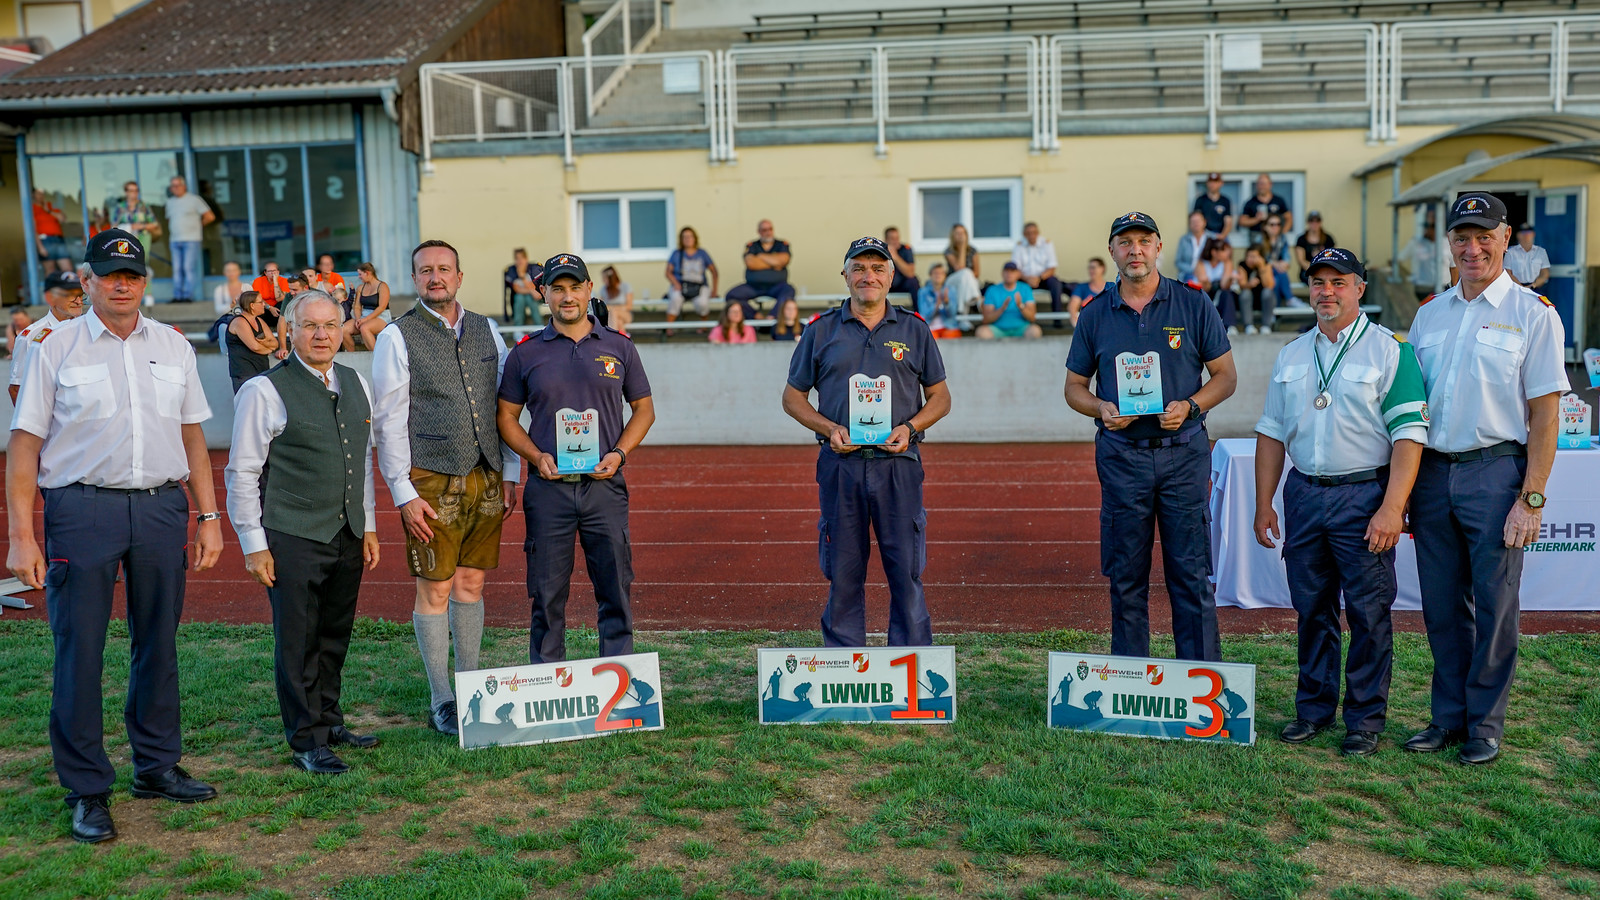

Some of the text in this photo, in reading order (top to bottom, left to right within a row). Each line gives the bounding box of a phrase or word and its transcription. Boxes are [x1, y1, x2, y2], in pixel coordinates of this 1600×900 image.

[1122, 356, 1154, 365] LWWLB
[1523, 542, 1596, 552] STEIERMARK
[1091, 668, 1143, 676] FEUERWEHR
[500, 676, 552, 686] FEUERWEHR
[822, 682, 894, 704] LWWLB
[525, 694, 600, 724] LWWLB
[1112, 694, 1188, 719] LWWLB
